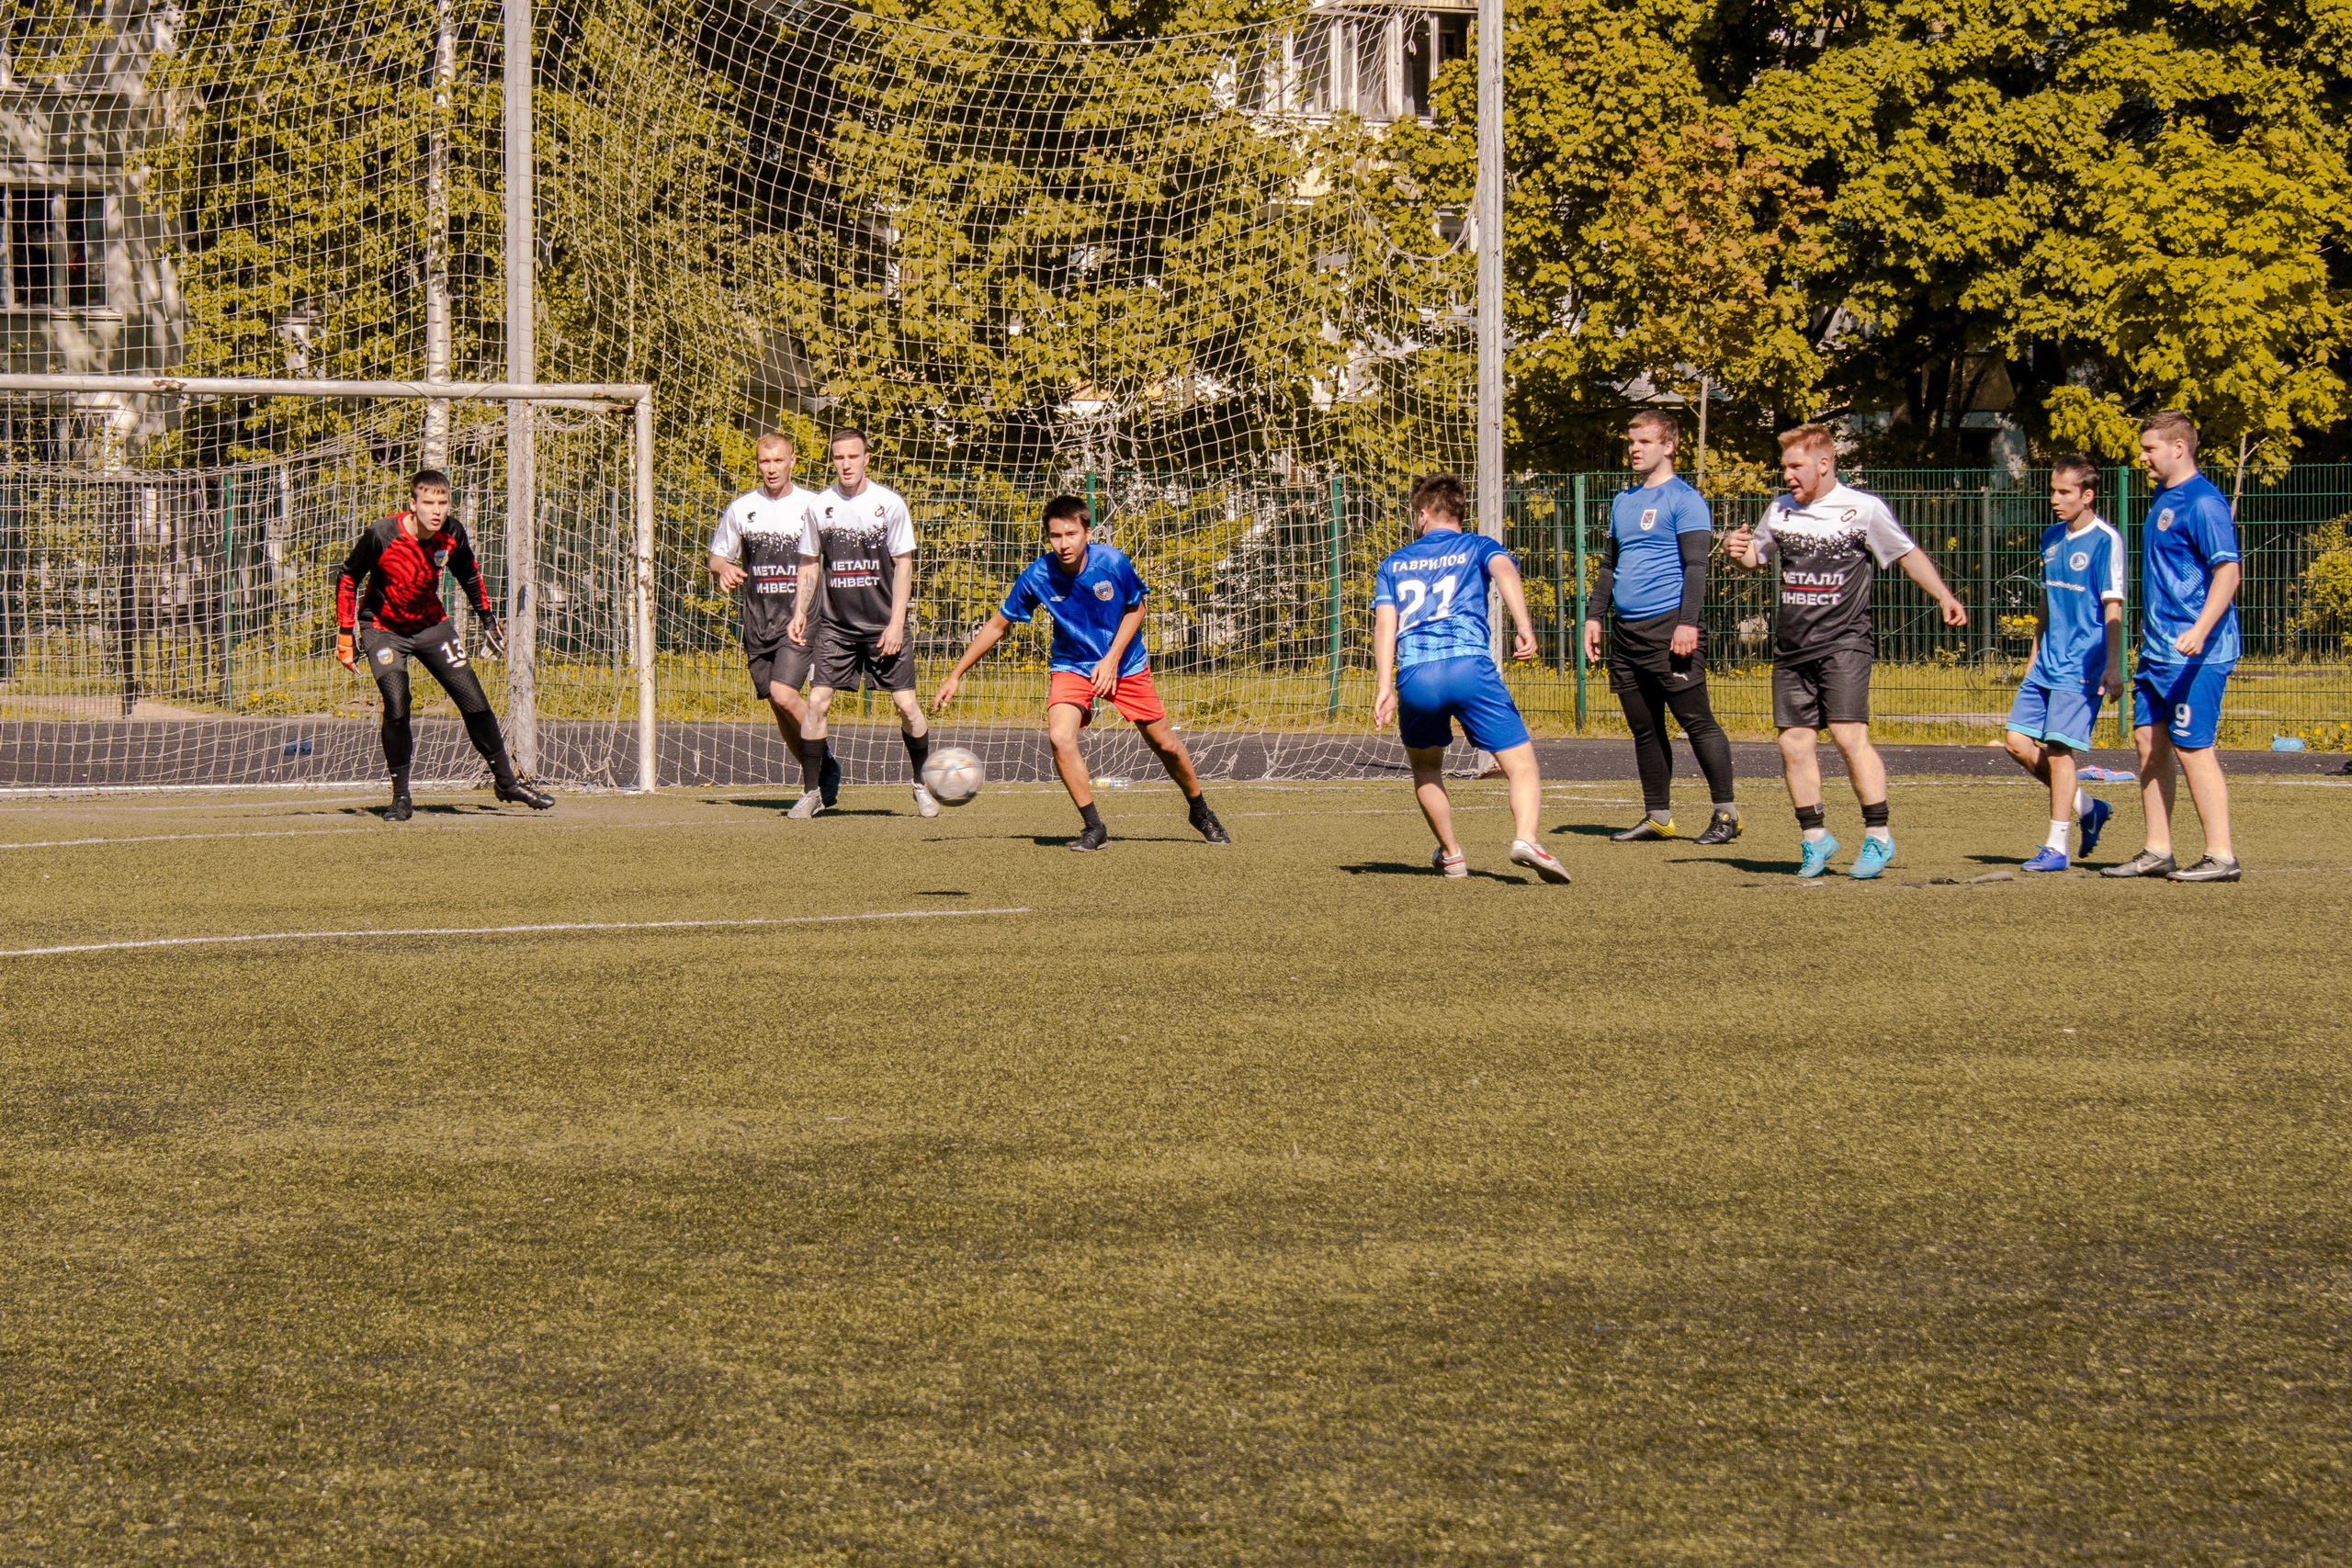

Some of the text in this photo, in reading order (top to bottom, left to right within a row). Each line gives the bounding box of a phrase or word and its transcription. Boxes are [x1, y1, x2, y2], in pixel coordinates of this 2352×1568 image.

[752, 564, 797, 577] МЕТАЛ
[1392, 552, 1466, 573] ГАВРИЛОВ
[756, 581, 797, 594] ИНВЕС
[830, 576, 880, 588] ИНВЕСТ
[1396, 574, 1456, 637] 21
[440, 637, 467, 663] 13
[2175, 703, 2191, 728] 9
